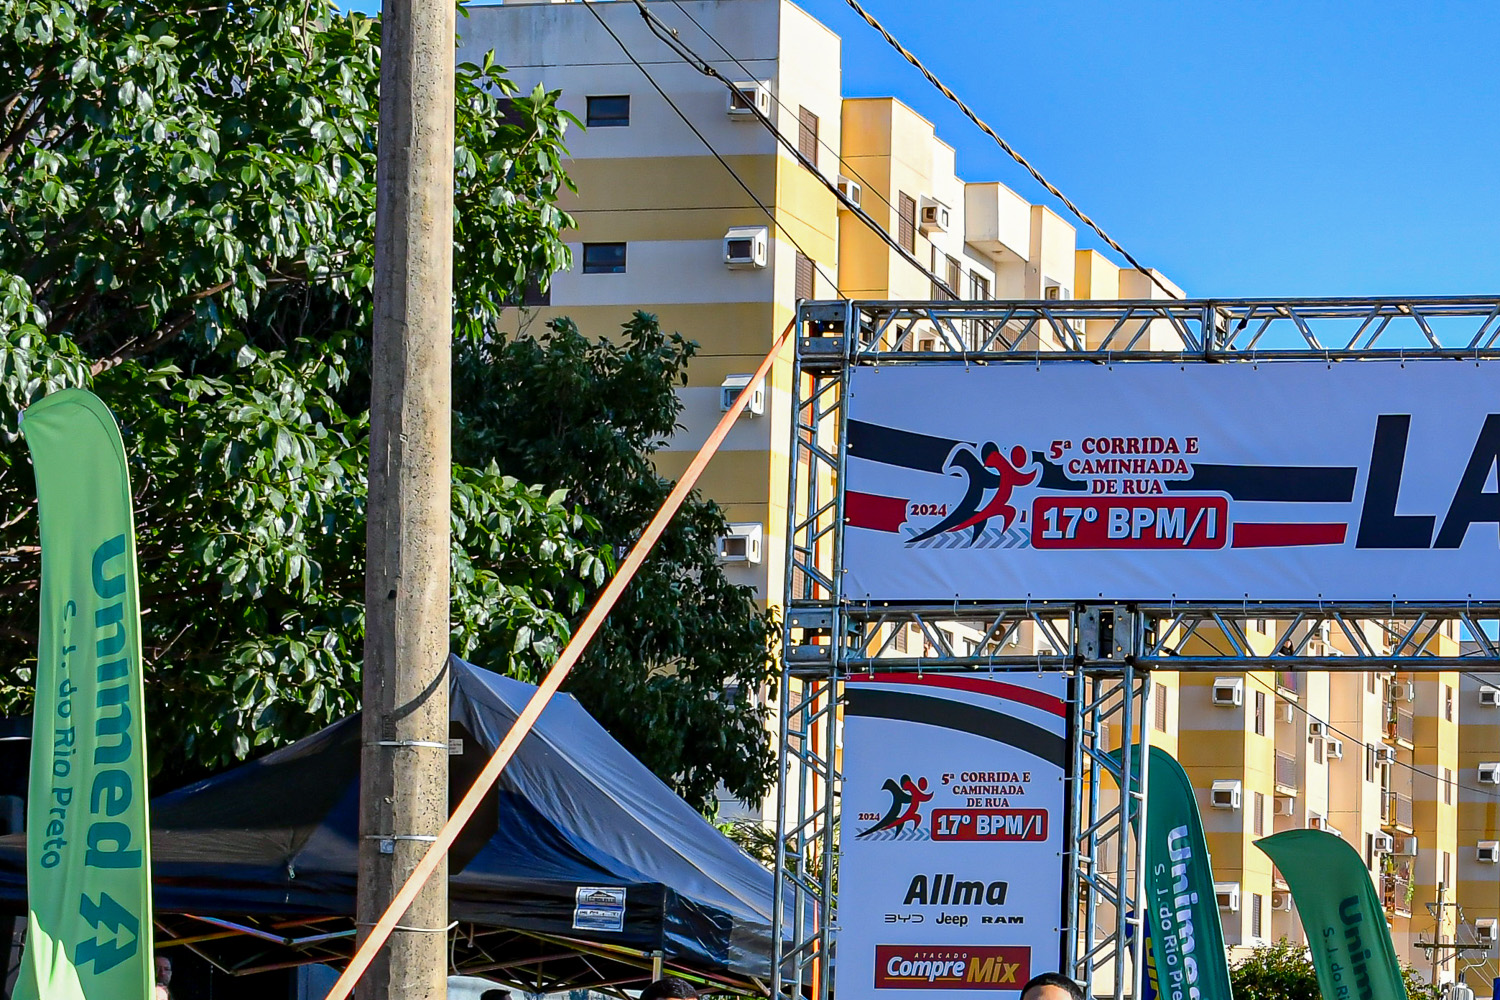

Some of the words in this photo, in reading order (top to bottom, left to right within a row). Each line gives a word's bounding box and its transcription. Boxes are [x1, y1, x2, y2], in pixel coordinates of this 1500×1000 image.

[1050, 438, 1072, 460] 5ª
[1082, 436, 1180, 455] CORRIDA
[1183, 436, 1199, 455] E
[1068, 457, 1189, 476] CAMINHADA
[1091, 479, 1118, 496] DE
[1123, 478, 1163, 496] RUA
[909, 503, 947, 518] 2024
[1042, 505, 1098, 541] 17º
[1106, 505, 1218, 547] BPM/I
[57, 678, 78, 718] do
[85, 533, 142, 869] Unimed
[53, 726, 77, 777] Rio
[941, 773, 955, 785] 5ª
[961, 772, 1020, 783] CORRIDA
[1022, 772, 1031, 783] E
[952, 785, 1025, 795] CAMINHADA
[966, 798, 983, 807] DE
[985, 798, 1010, 808] RUA
[40, 787, 73, 868] Preto
[858, 813, 880, 821] 2024
[937, 815, 970, 835] 17º
[976, 815, 1042, 840] BPM/I
[902, 874, 1009, 906] Allma
[936, 912, 968, 927] Jeep
[981, 916, 1024, 924] RAM
[1160, 906, 1173, 930] do
[1164, 935, 1179, 966] Rio
[886, 956, 966, 982] Compre
[966, 956, 1020, 983] Mix
[1330, 962, 1344, 982] do
